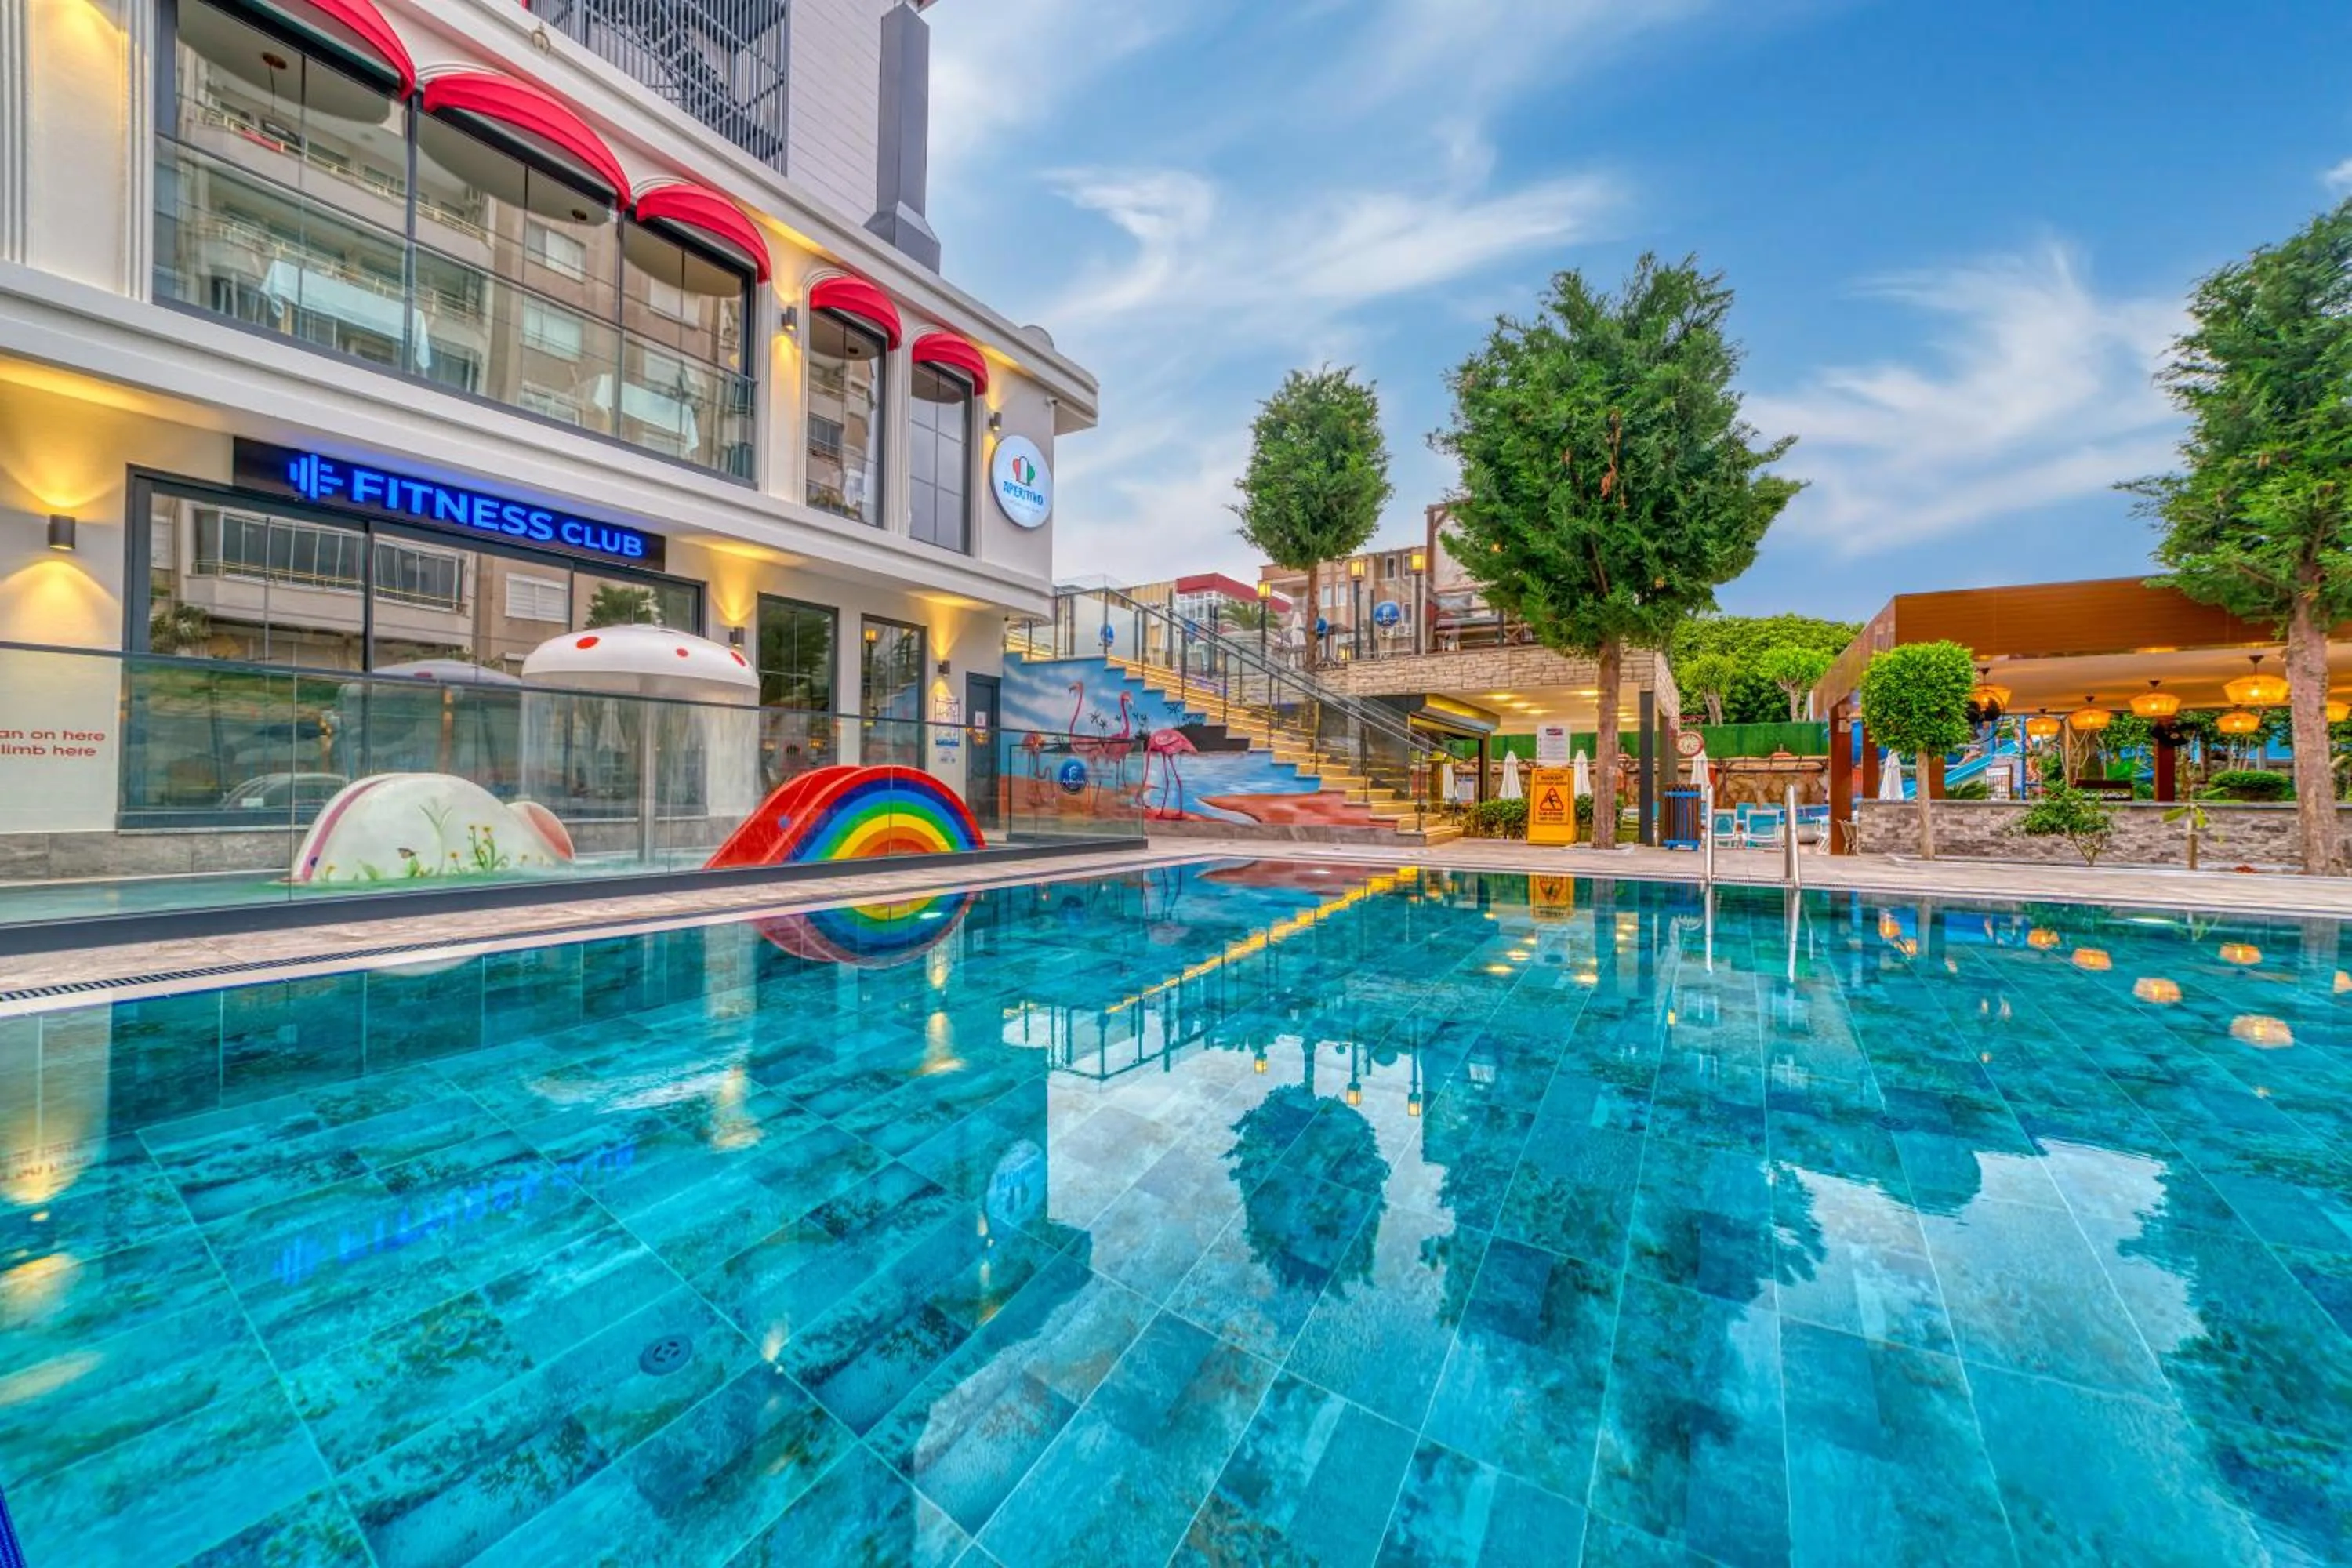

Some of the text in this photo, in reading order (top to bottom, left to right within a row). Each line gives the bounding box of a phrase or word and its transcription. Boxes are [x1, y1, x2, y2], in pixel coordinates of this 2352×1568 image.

[352, 469, 644, 557] FITNESS CLUB
[31, 731, 56, 740] on
[63, 730, 106, 741] here
[53, 744, 97, 757] here
